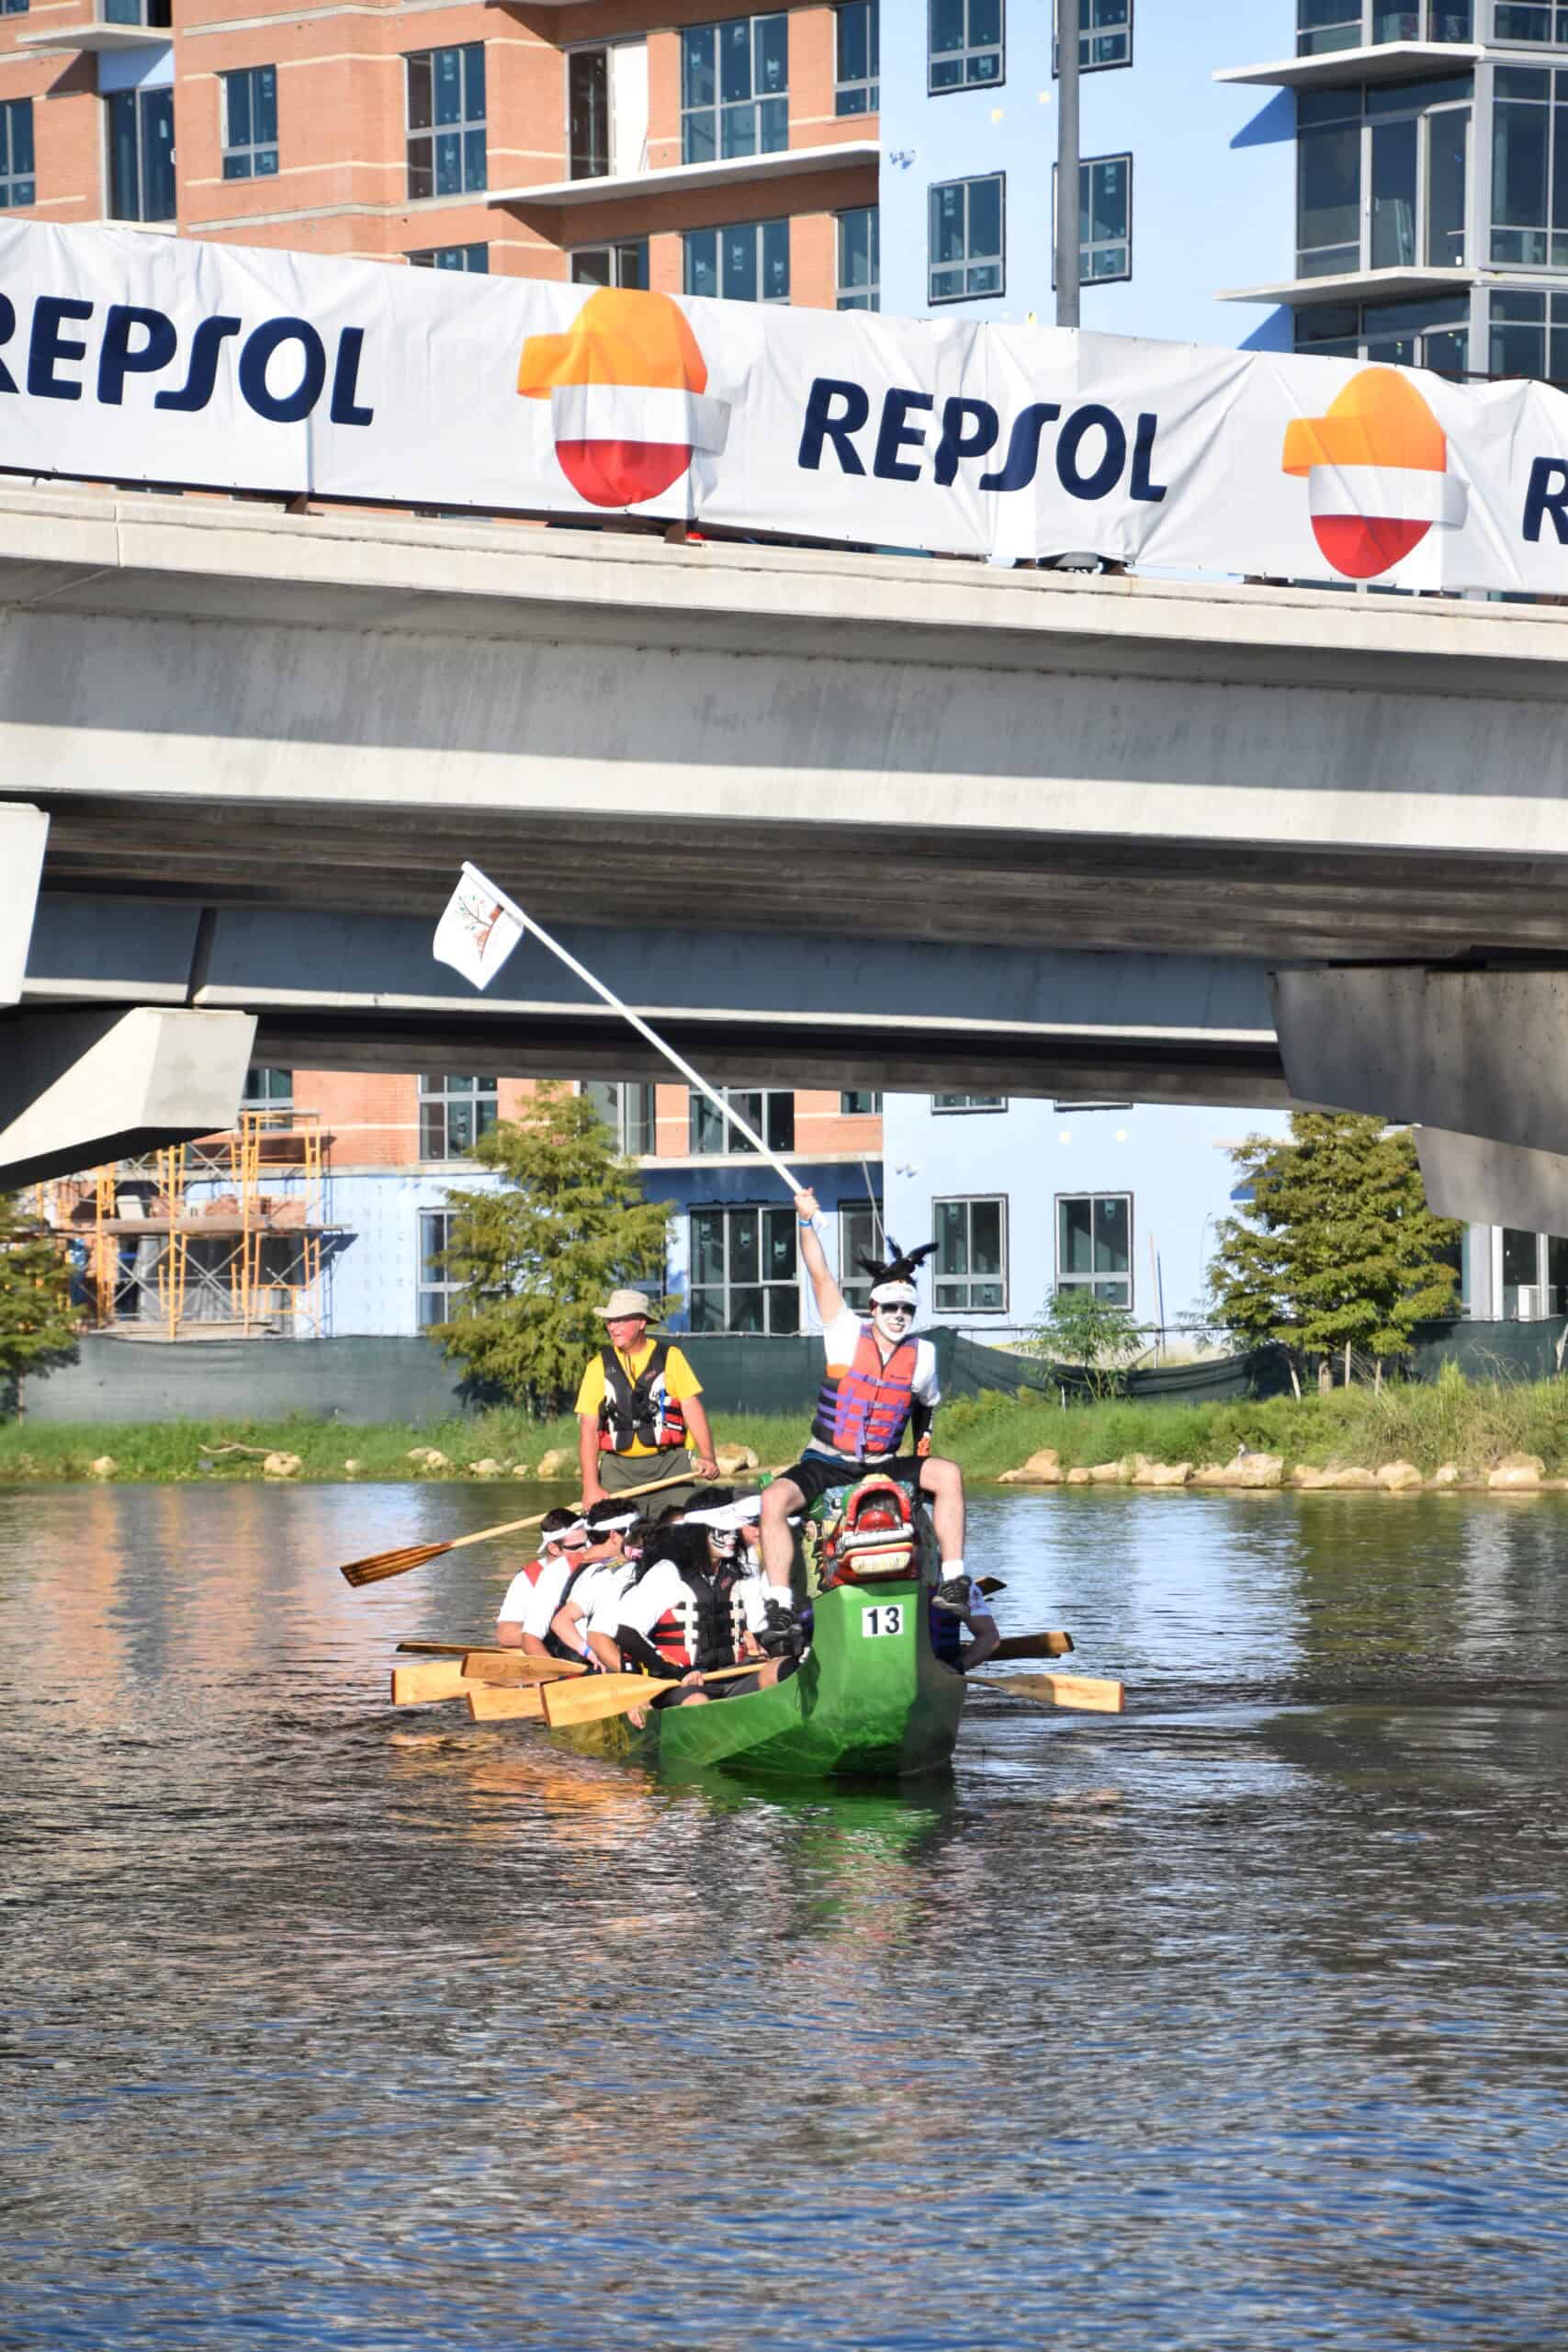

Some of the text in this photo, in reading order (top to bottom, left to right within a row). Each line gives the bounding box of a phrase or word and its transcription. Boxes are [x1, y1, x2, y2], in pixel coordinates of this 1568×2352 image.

[0, 292, 374, 426] EPSOL
[798, 378, 1168, 503] REPSOL
[866, 1607, 900, 1635] 13
